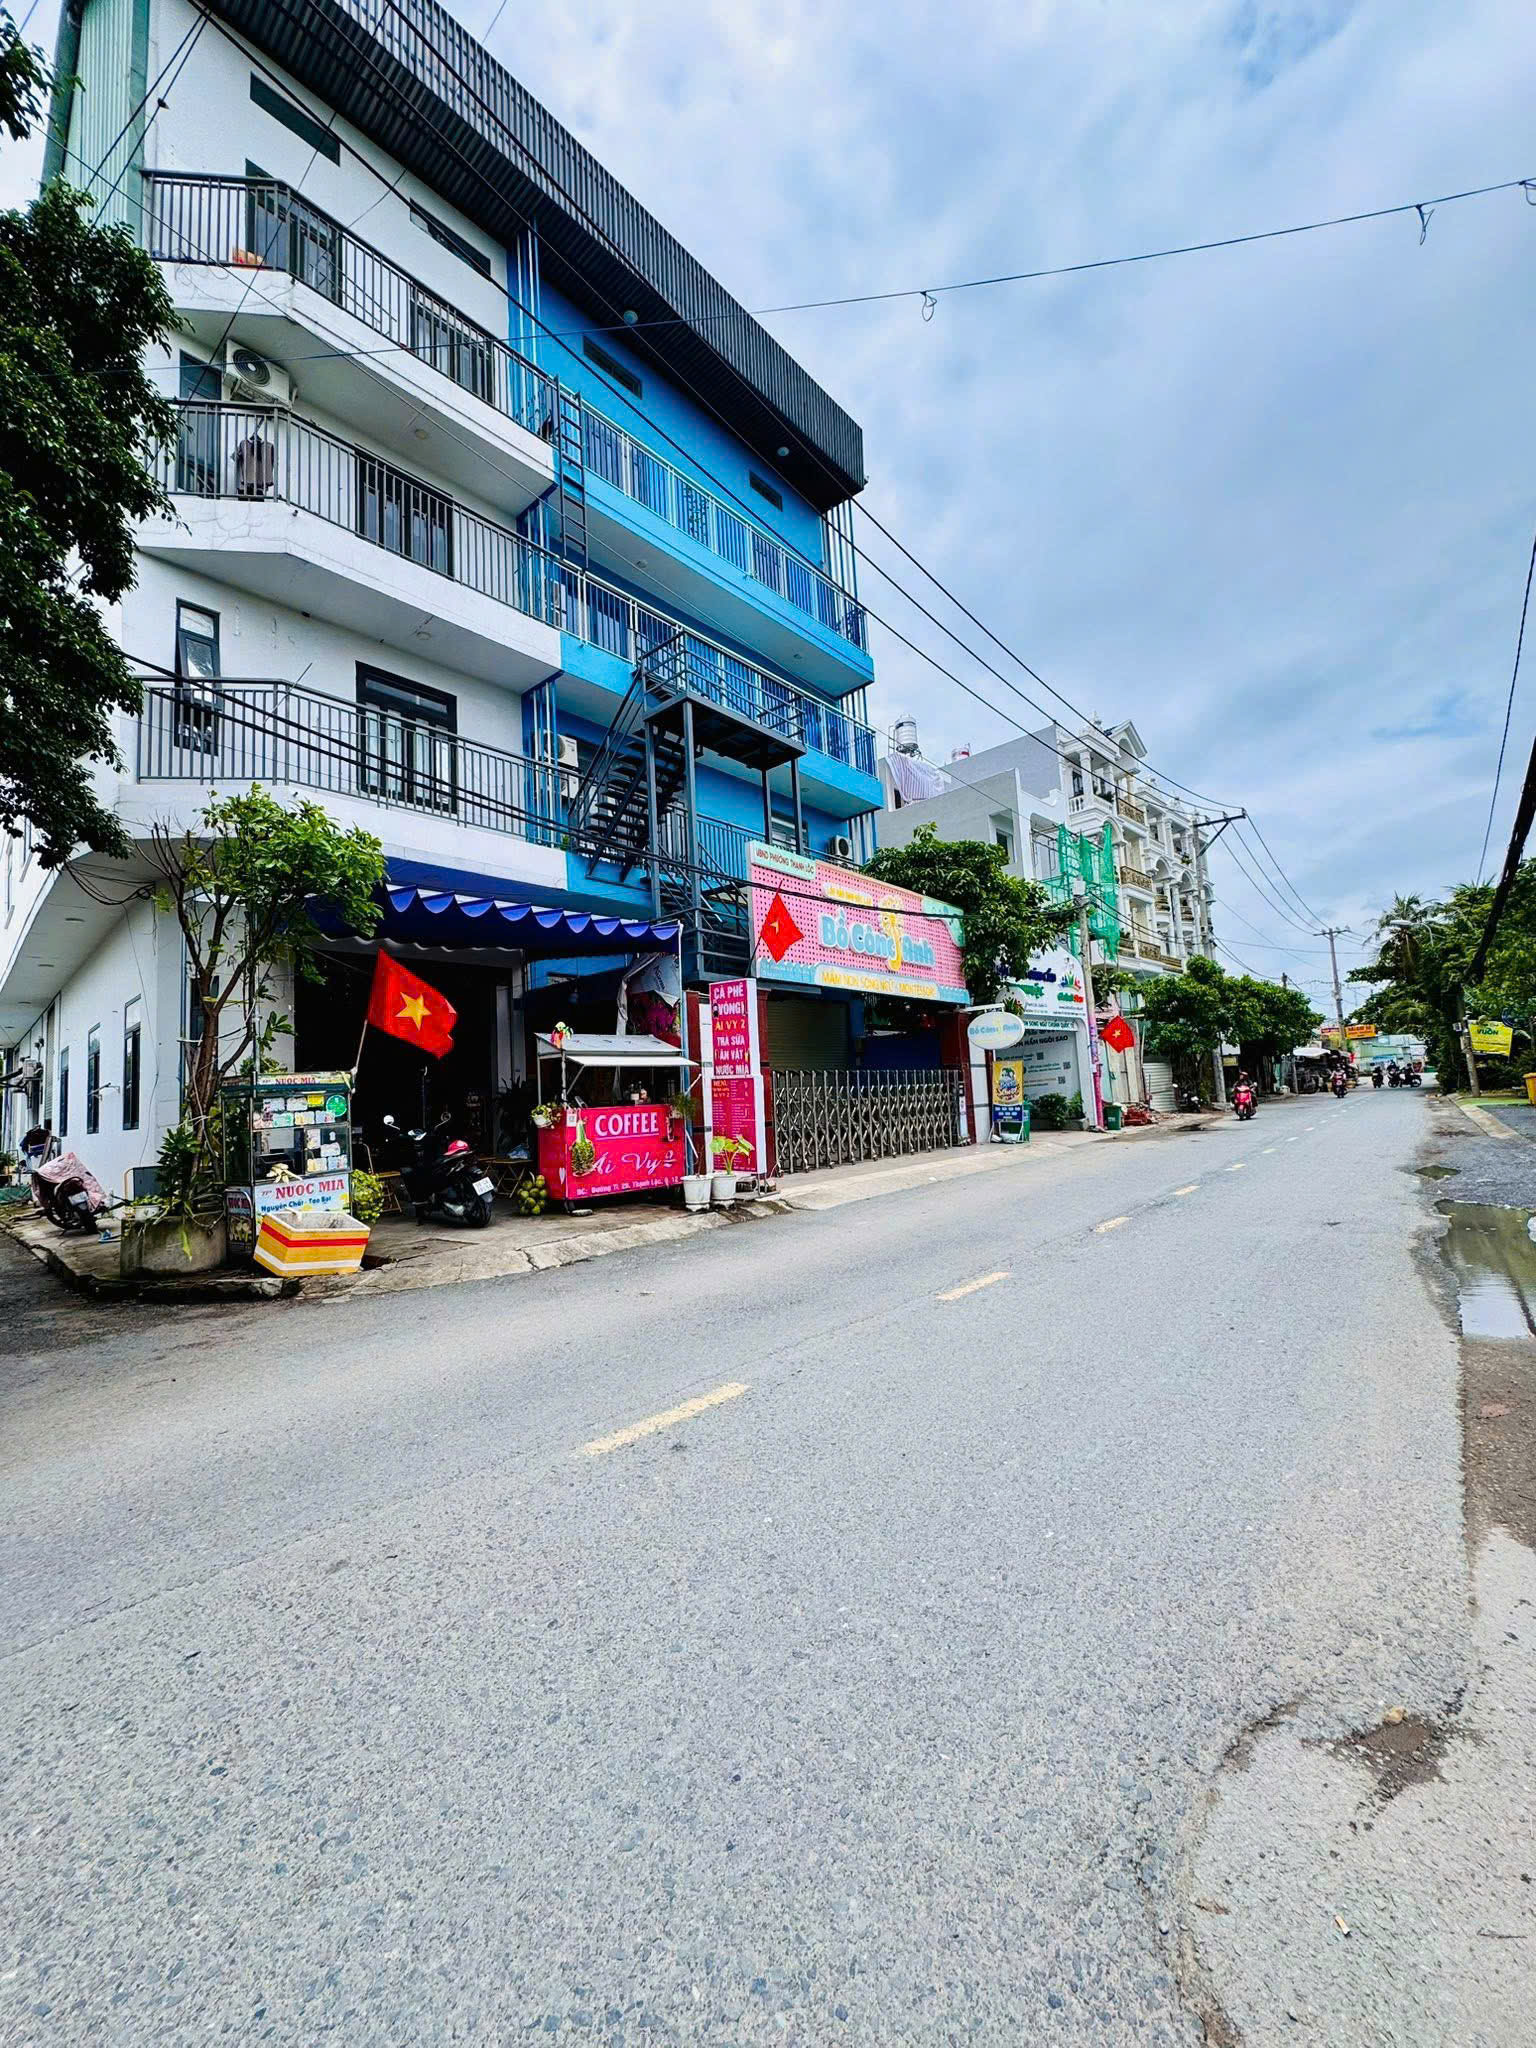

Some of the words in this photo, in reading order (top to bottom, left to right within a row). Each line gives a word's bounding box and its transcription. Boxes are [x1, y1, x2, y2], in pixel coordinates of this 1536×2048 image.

[821, 907, 850, 949] Bồ
[901, 935, 935, 966] Anh
[713, 985, 725, 1000] CÀ
[727, 982, 745, 999] PHÊ
[740, 1019, 746, 1029] 2
[716, 1035, 730, 1047] TRÀ
[730, 1033, 745, 1046] SỮA
[595, 1112, 659, 1137] COFFEE
